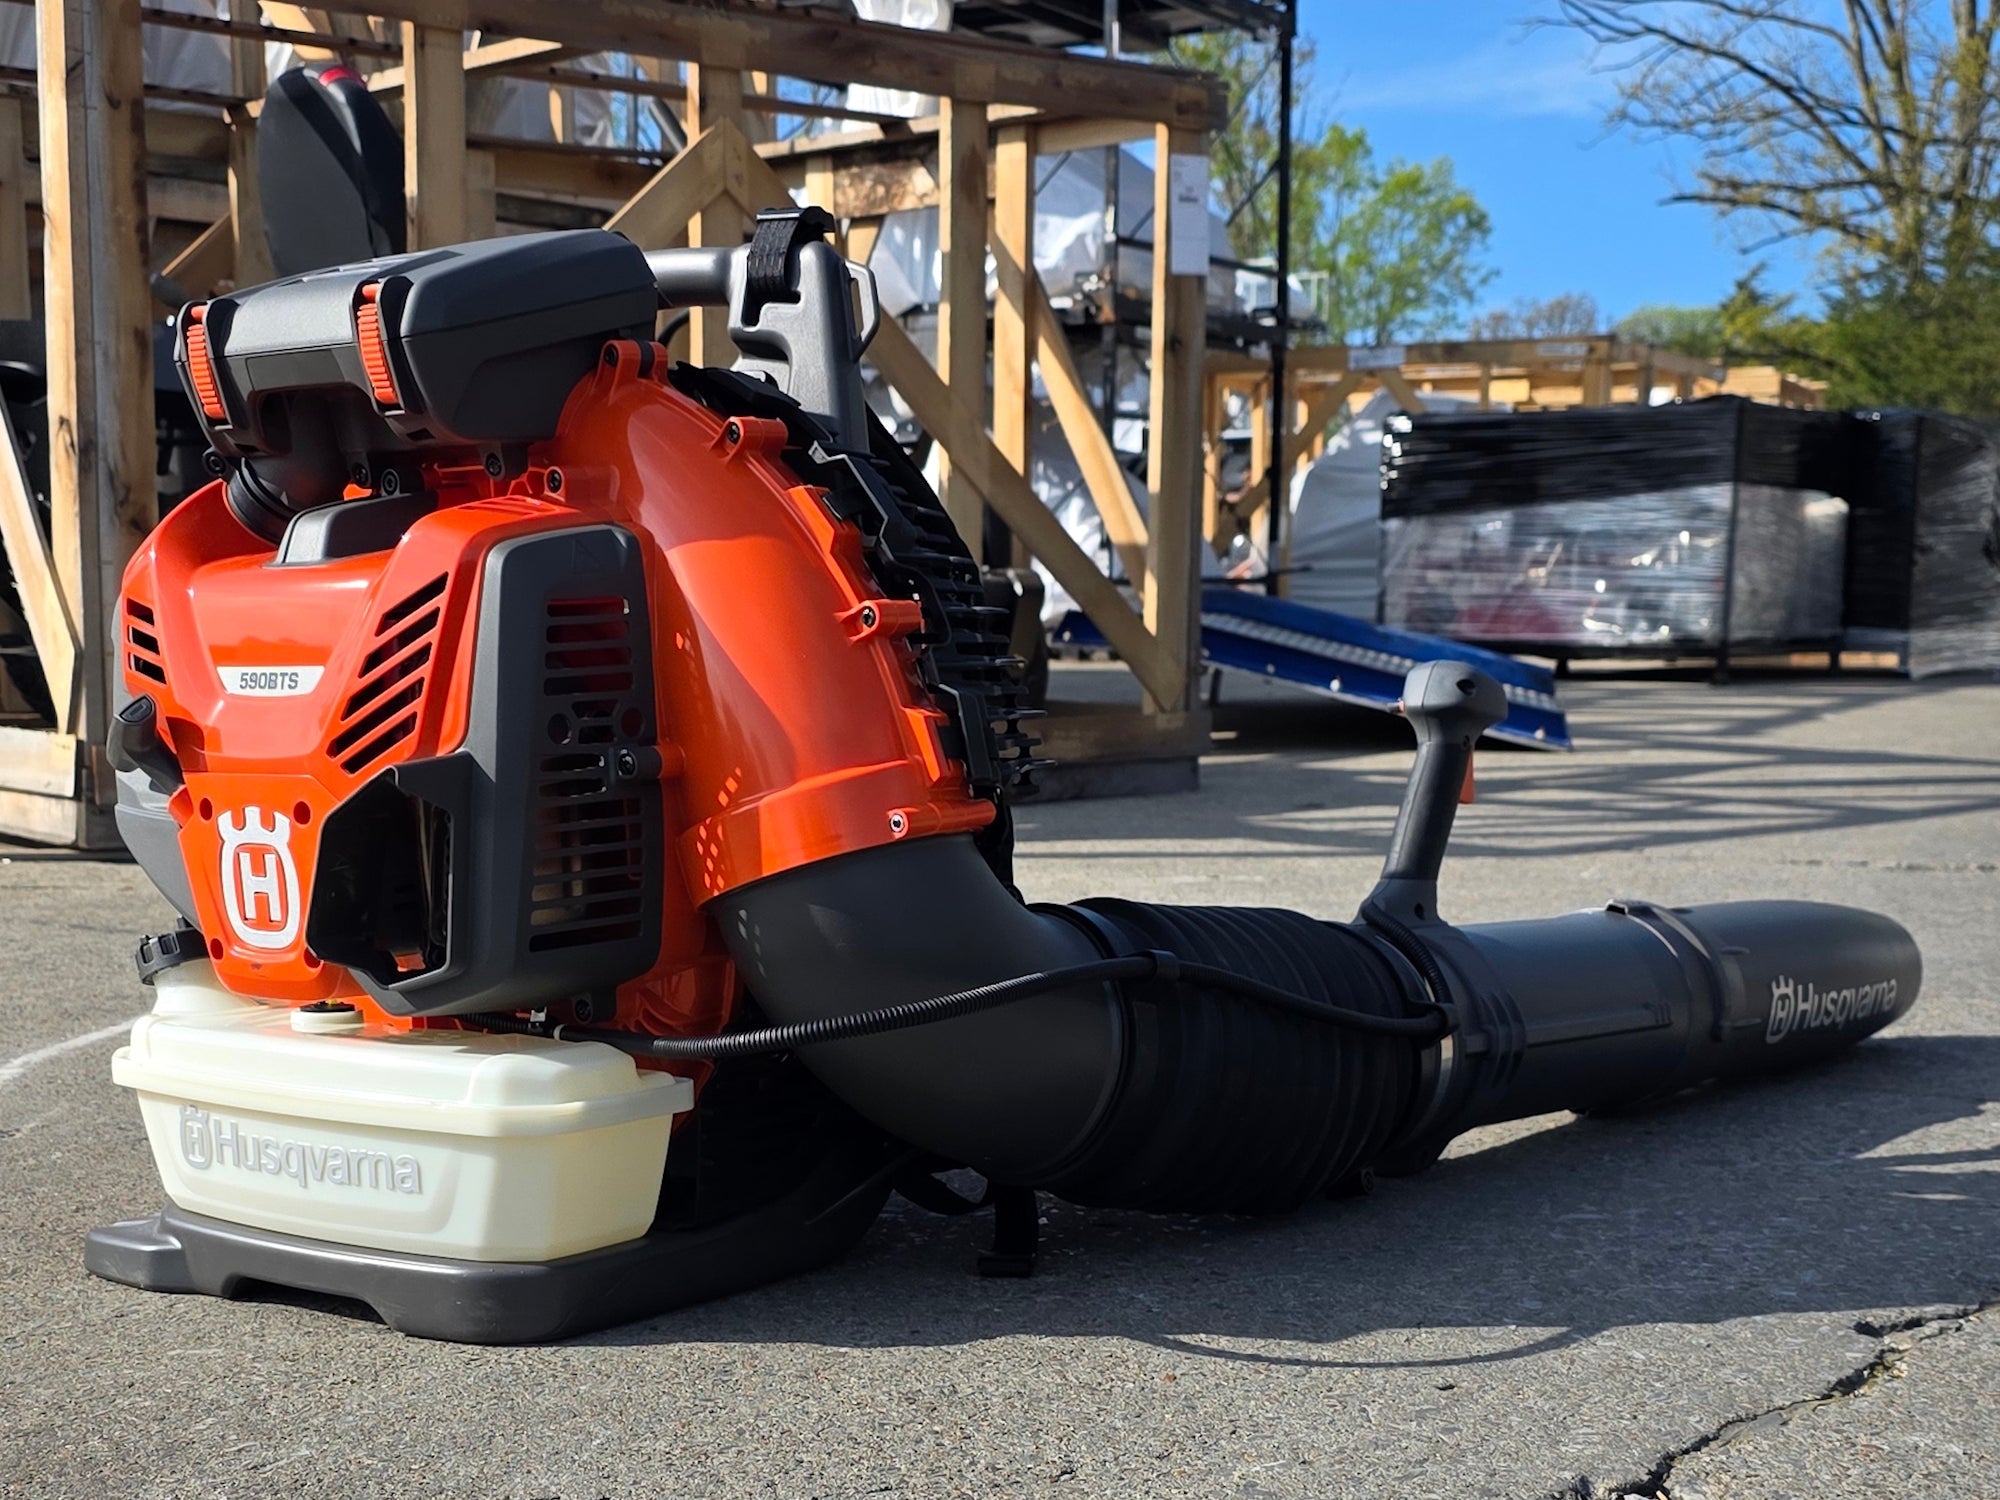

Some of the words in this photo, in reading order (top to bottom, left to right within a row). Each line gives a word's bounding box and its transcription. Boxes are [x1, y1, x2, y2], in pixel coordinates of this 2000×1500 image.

[239, 671, 299, 690] 590BTS
[238, 851, 282, 923] H
[1792, 977, 1897, 1030] Husqvarna
[213, 1116, 422, 1194] Husqvarna
